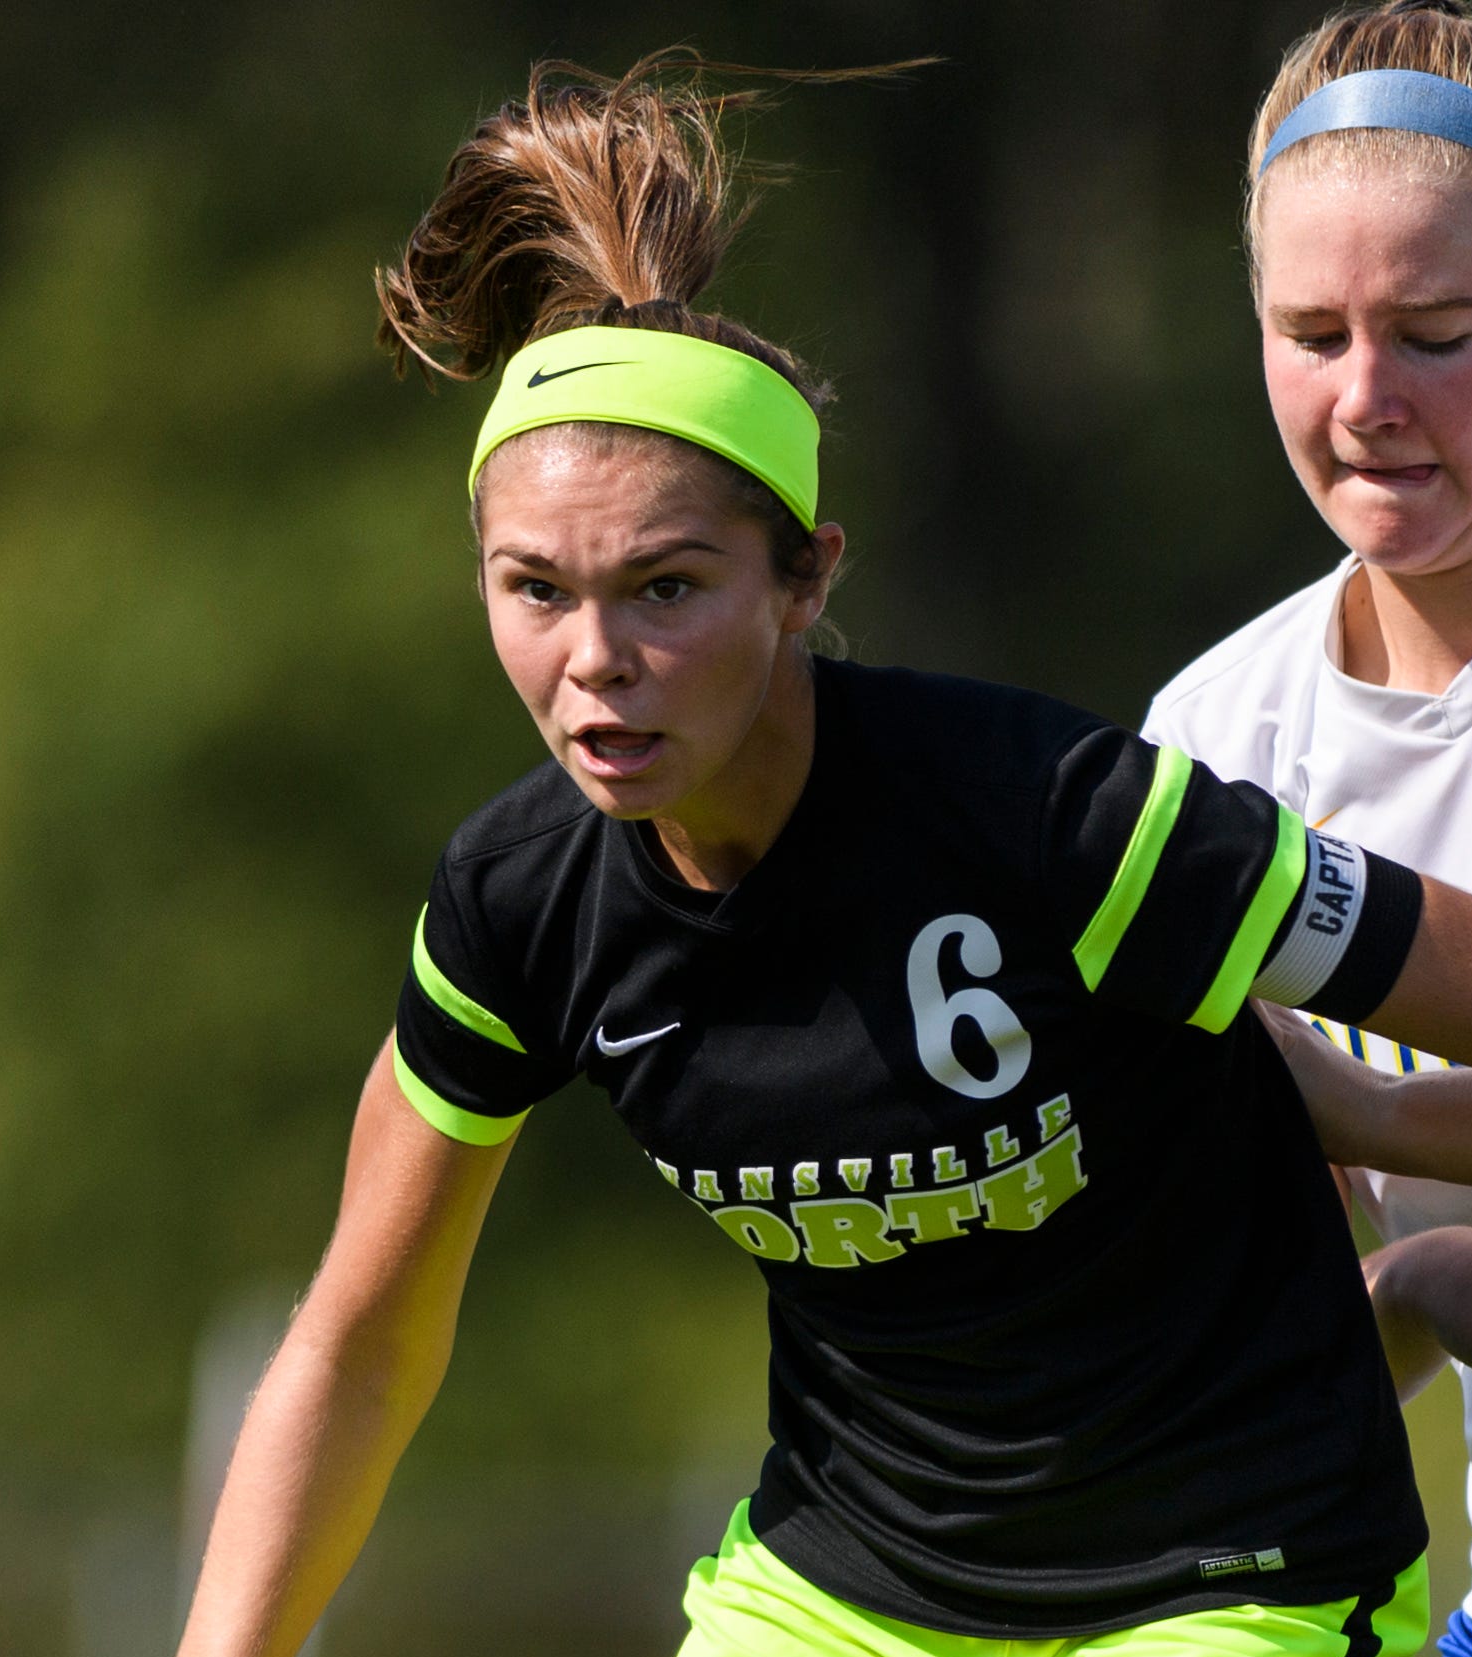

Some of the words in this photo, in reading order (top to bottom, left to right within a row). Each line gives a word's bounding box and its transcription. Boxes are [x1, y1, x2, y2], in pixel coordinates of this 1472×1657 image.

[907, 914, 1032, 1099] 6
[645, 1093, 1071, 1202] VANSVILLE
[687, 1124, 1088, 1267] ORTH
[1204, 1556, 1255, 1572] AUTHENTIC
